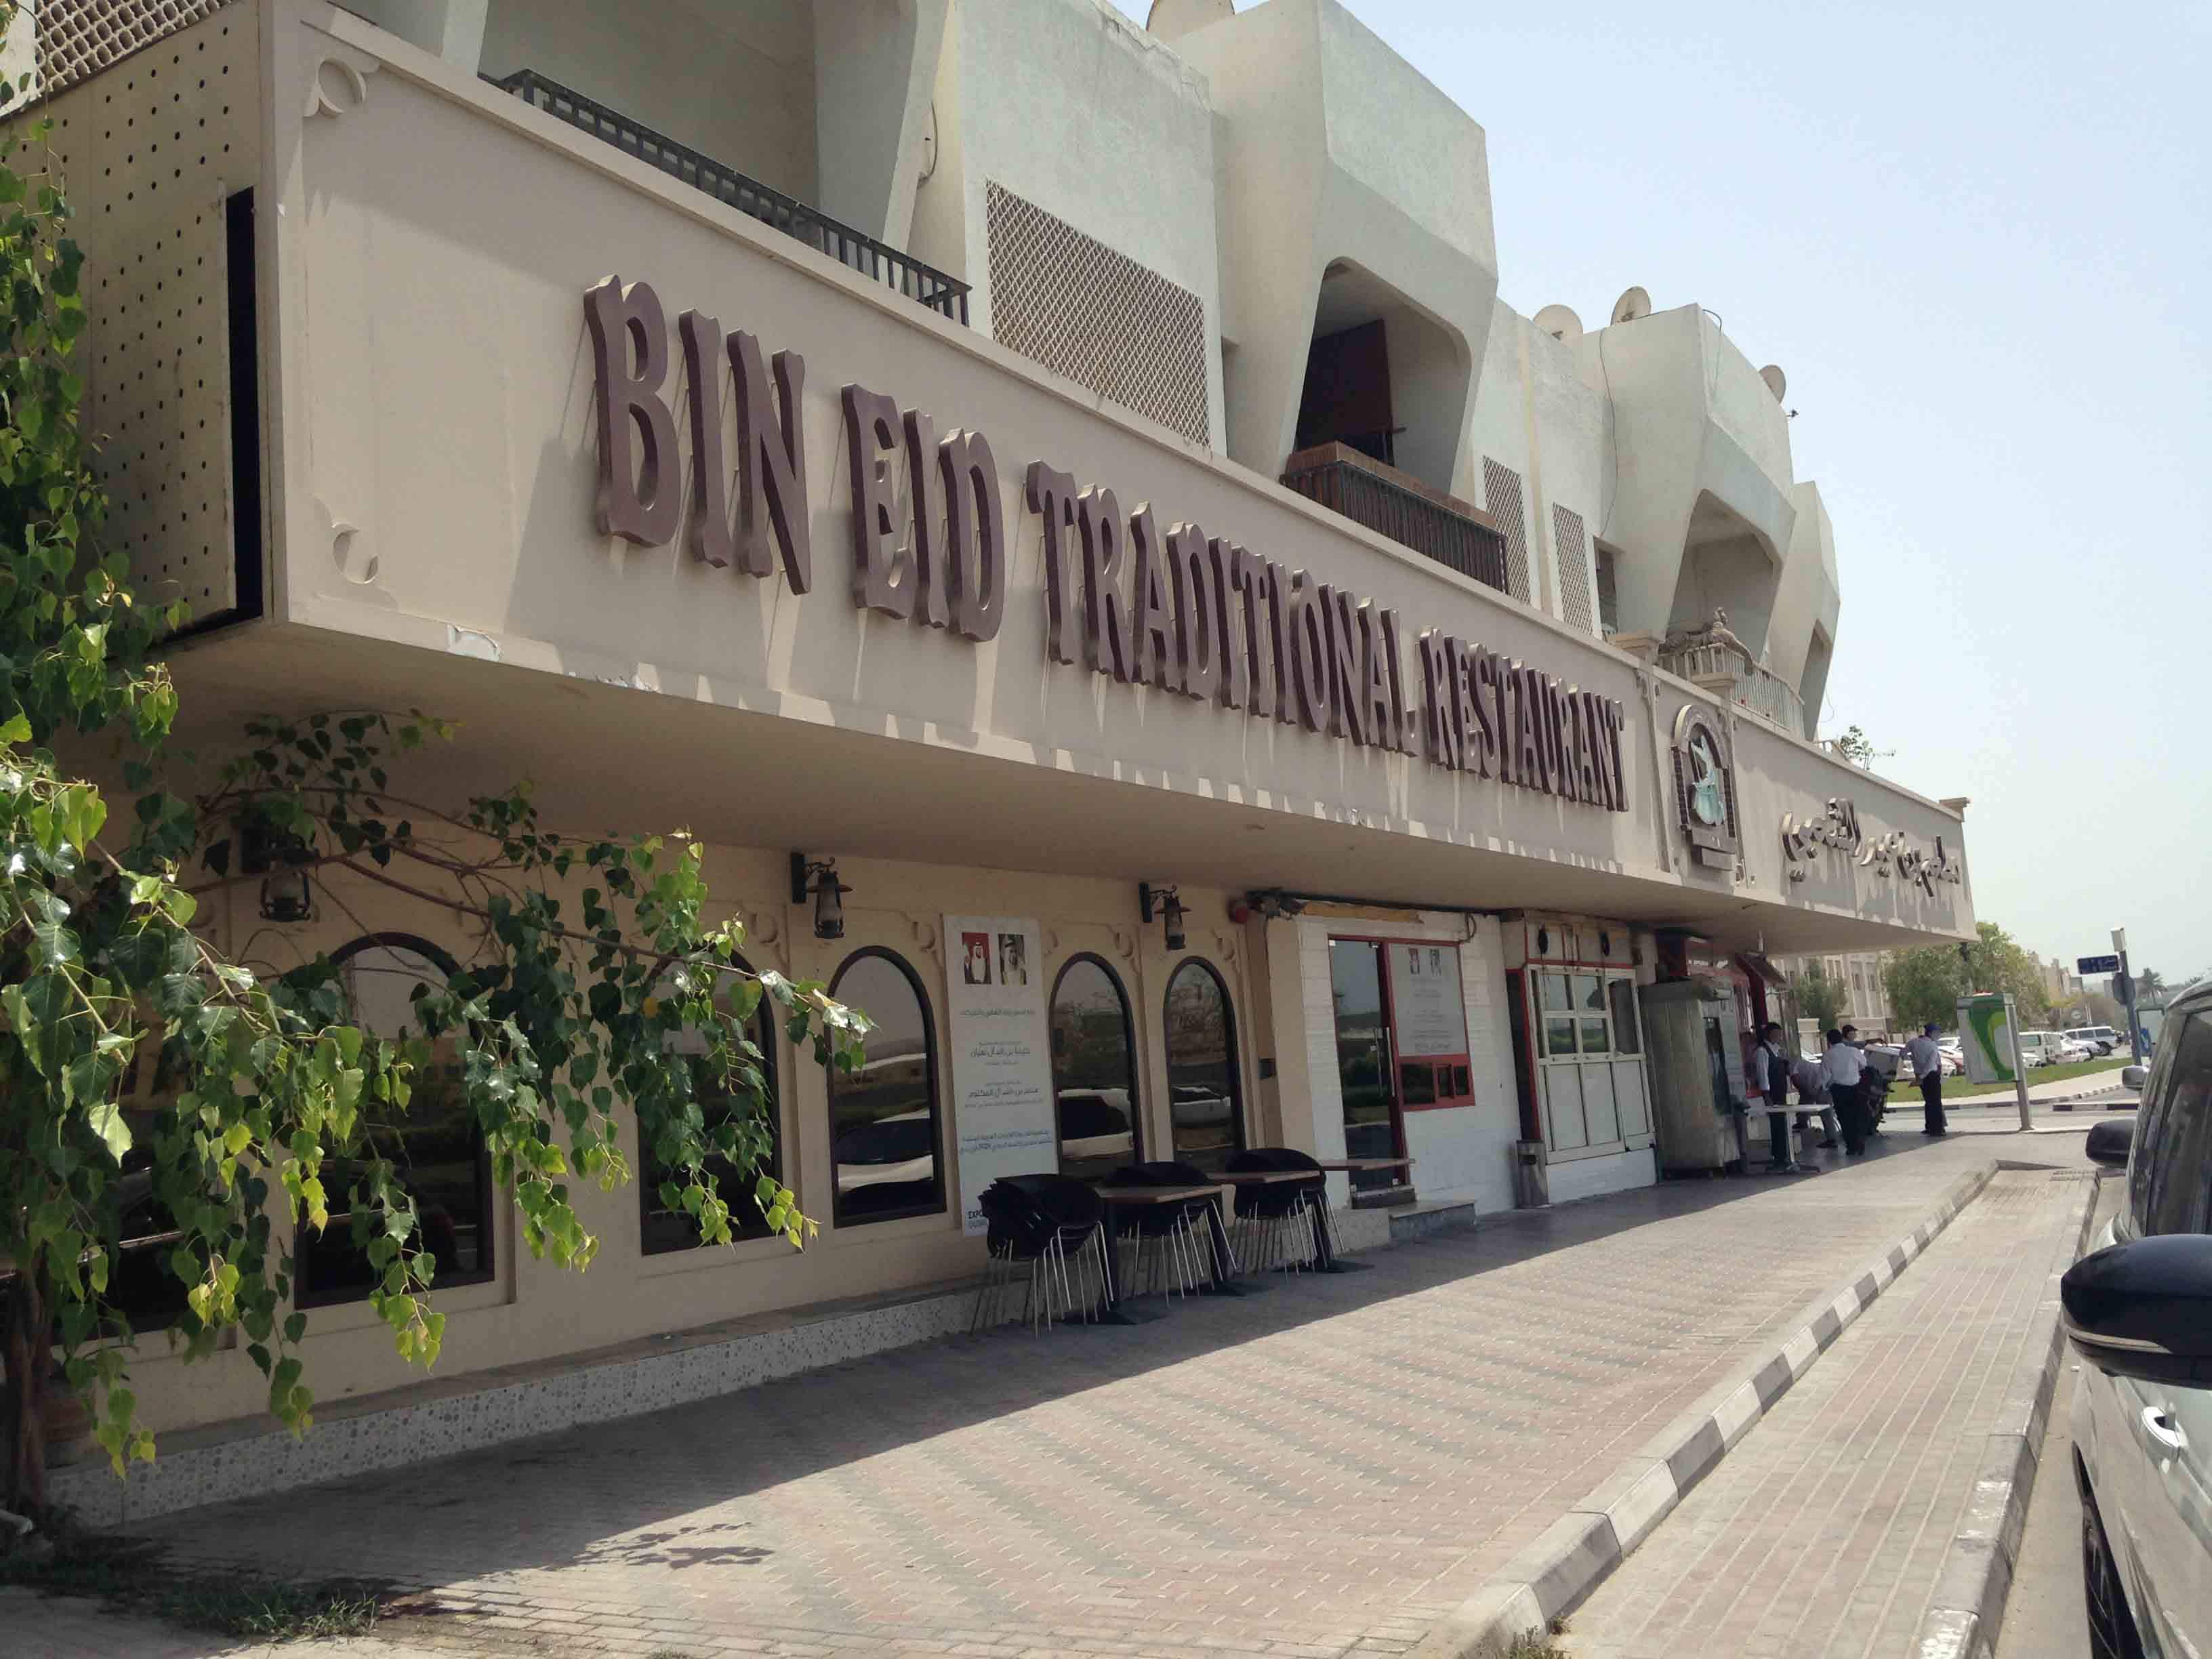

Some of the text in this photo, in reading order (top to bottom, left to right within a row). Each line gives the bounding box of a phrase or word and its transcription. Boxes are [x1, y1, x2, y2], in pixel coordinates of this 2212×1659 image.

[583, 274, 1629, 812] BIN EID TRADITIONAL RESTAURANT
